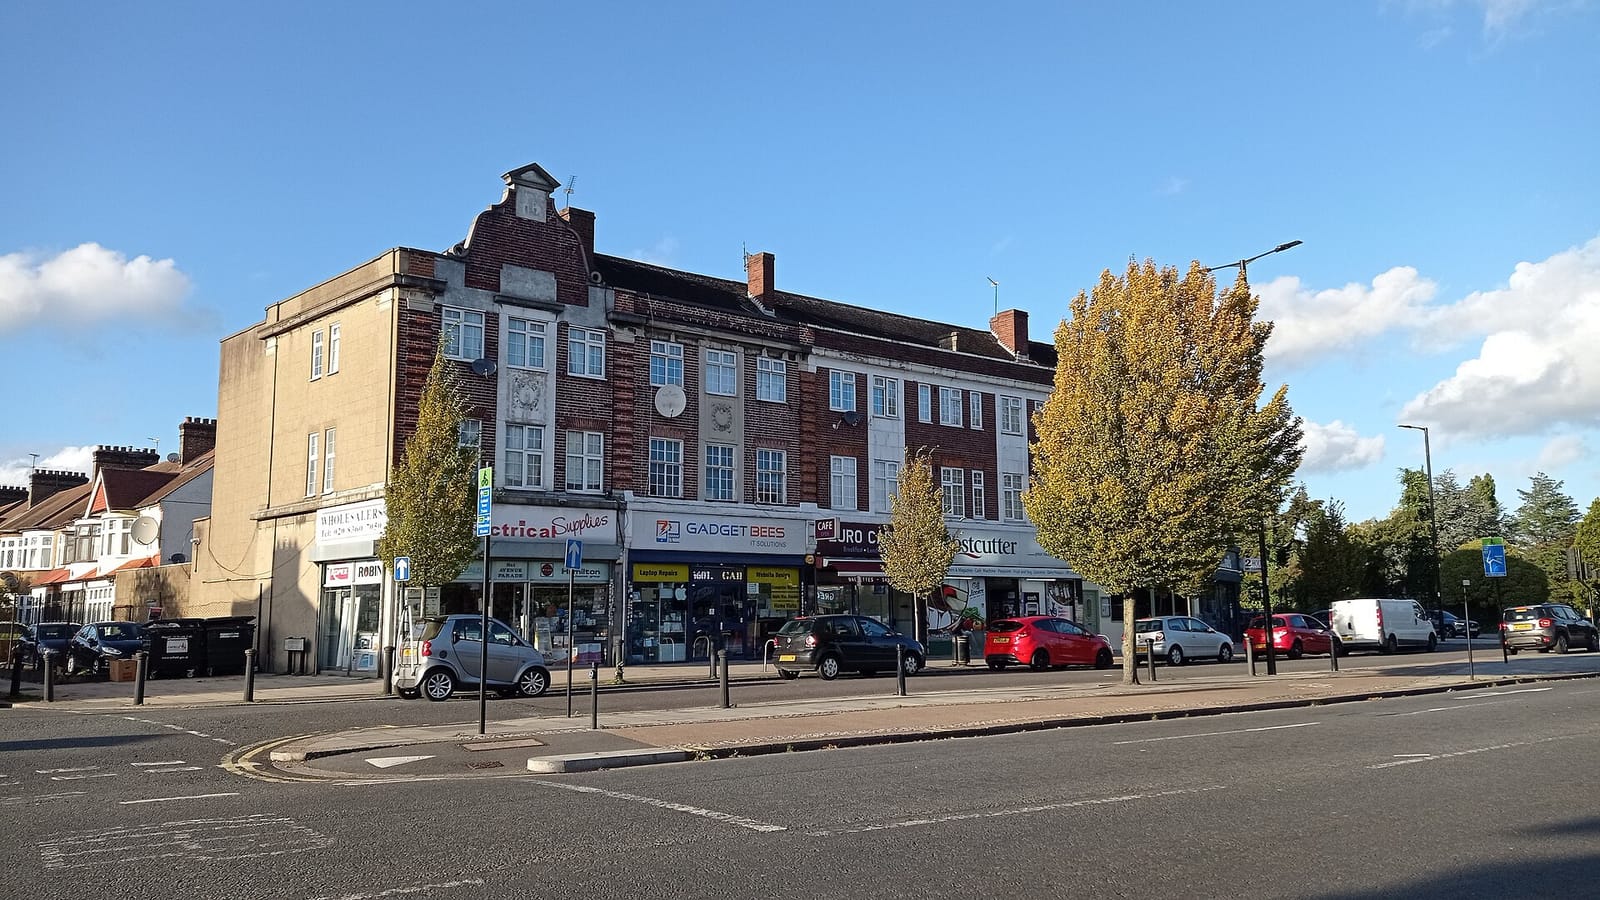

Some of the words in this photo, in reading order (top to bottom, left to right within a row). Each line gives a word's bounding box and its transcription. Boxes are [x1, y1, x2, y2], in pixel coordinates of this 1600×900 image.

[321, 508, 383, 526] WHOLESALERS
[491, 520, 556, 538] ctrical
[552, 512, 608, 536] Supplies
[686, 522, 748, 537] GADGET
[750, 526, 785, 538] BEES
[817, 521, 833, 530] CAFE
[829, 528, 863, 544] URO
[948, 536, 1017, 555] ostcutter
[358, 565, 381, 578] ROBIN
[561, 567, 600, 575] Hmilton
